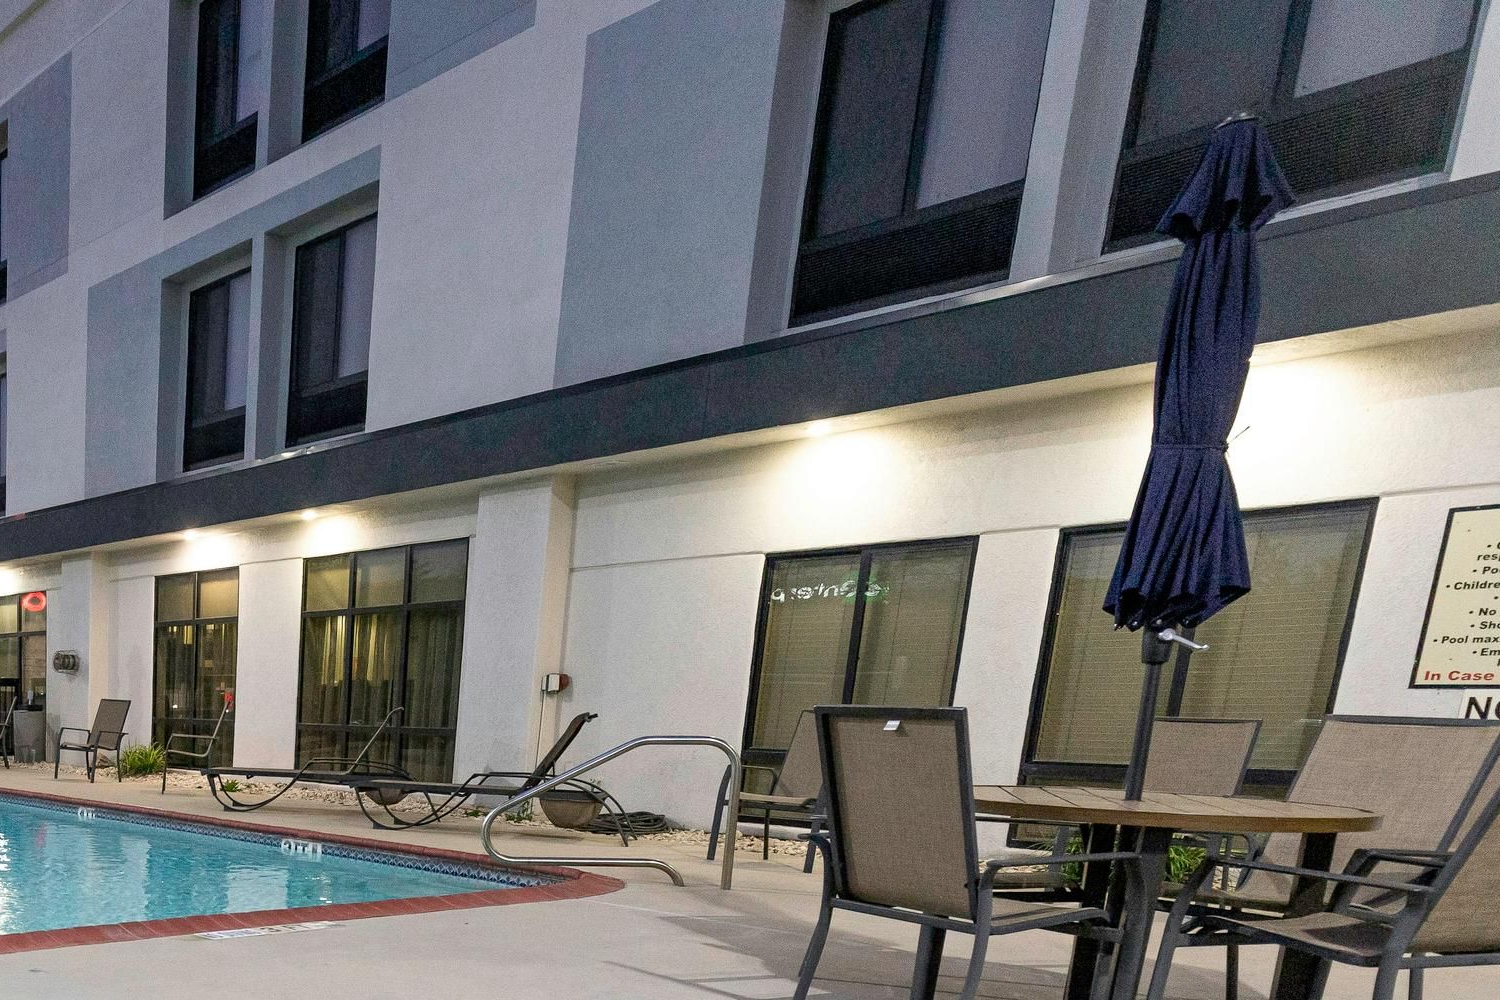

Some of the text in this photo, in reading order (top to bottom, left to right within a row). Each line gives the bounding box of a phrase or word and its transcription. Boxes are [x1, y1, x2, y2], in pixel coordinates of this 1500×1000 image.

[1477, 552, 1500, 562] res
[1482, 566, 1500, 575] Po
[1478, 608, 1497, 616] No
[1441, 636, 1469, 644] Pool
[1424, 671, 1495, 681] In Case
[1464, 697, 1500, 720] N
